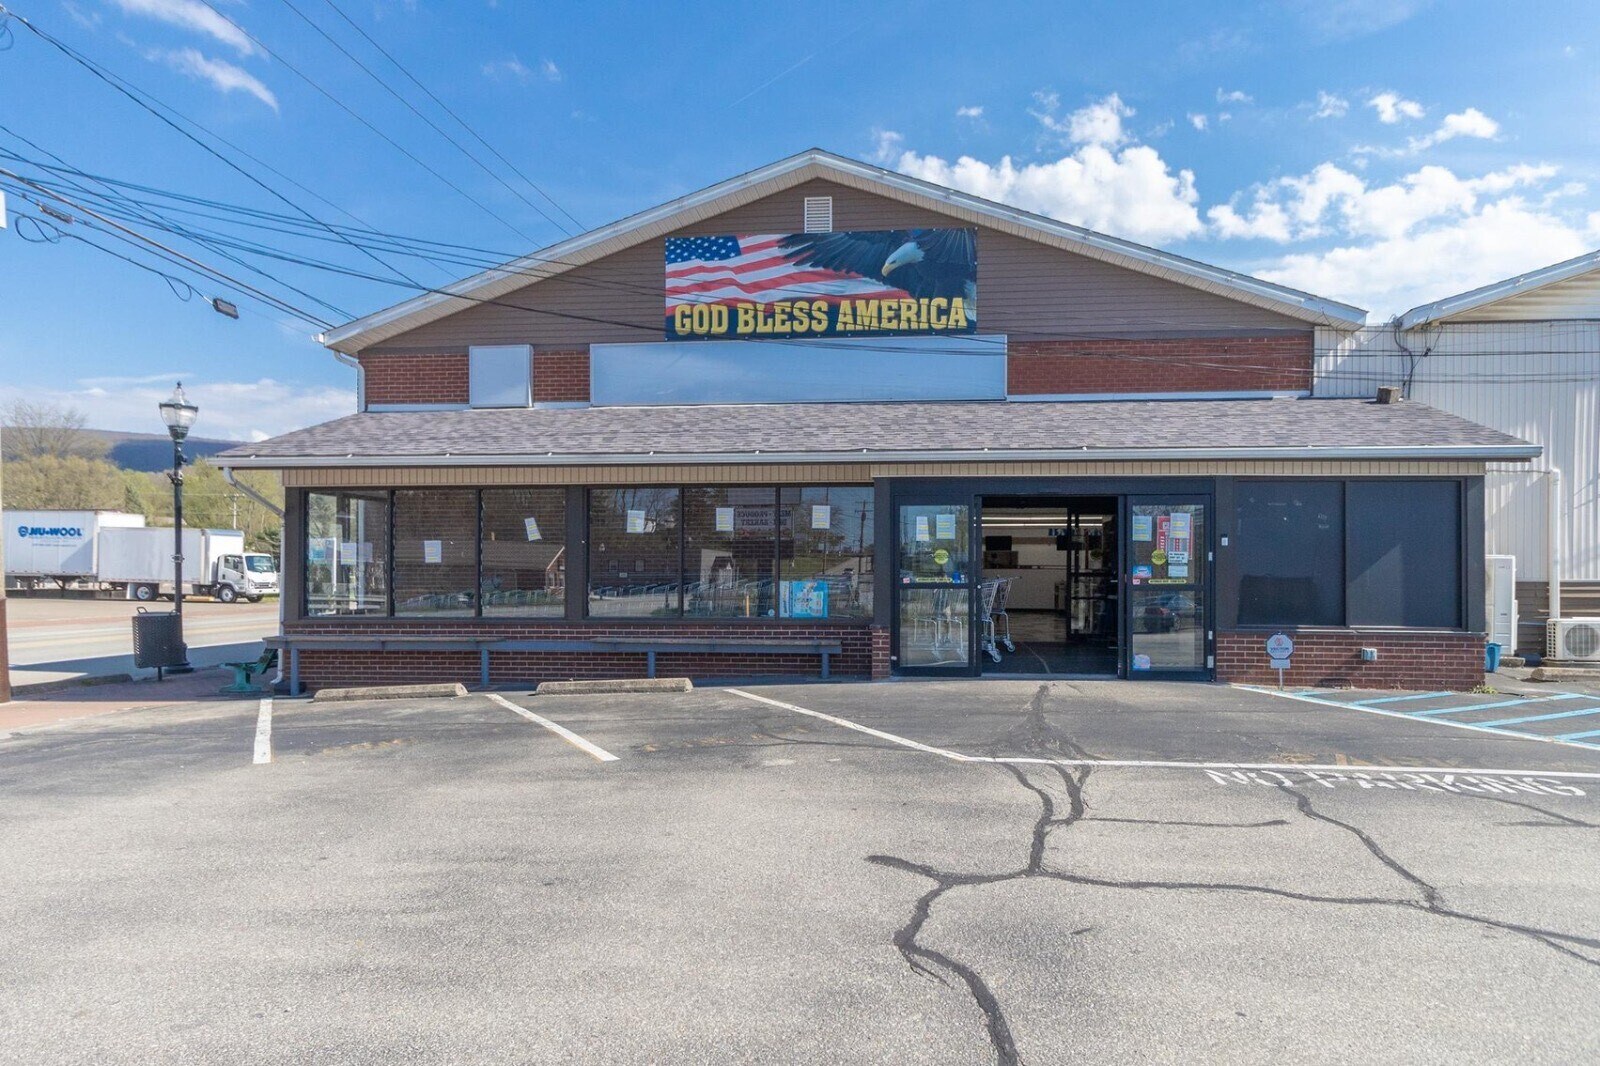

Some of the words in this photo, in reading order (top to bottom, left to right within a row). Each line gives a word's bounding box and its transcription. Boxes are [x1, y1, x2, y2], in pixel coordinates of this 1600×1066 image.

[674, 304, 729, 335] GOD
[736, 300, 829, 335] BLESS
[835, 297, 968, 332] AMERICA
[1204, 769, 1294, 787] NO
[1303, 770, 1586, 797] PARKING
